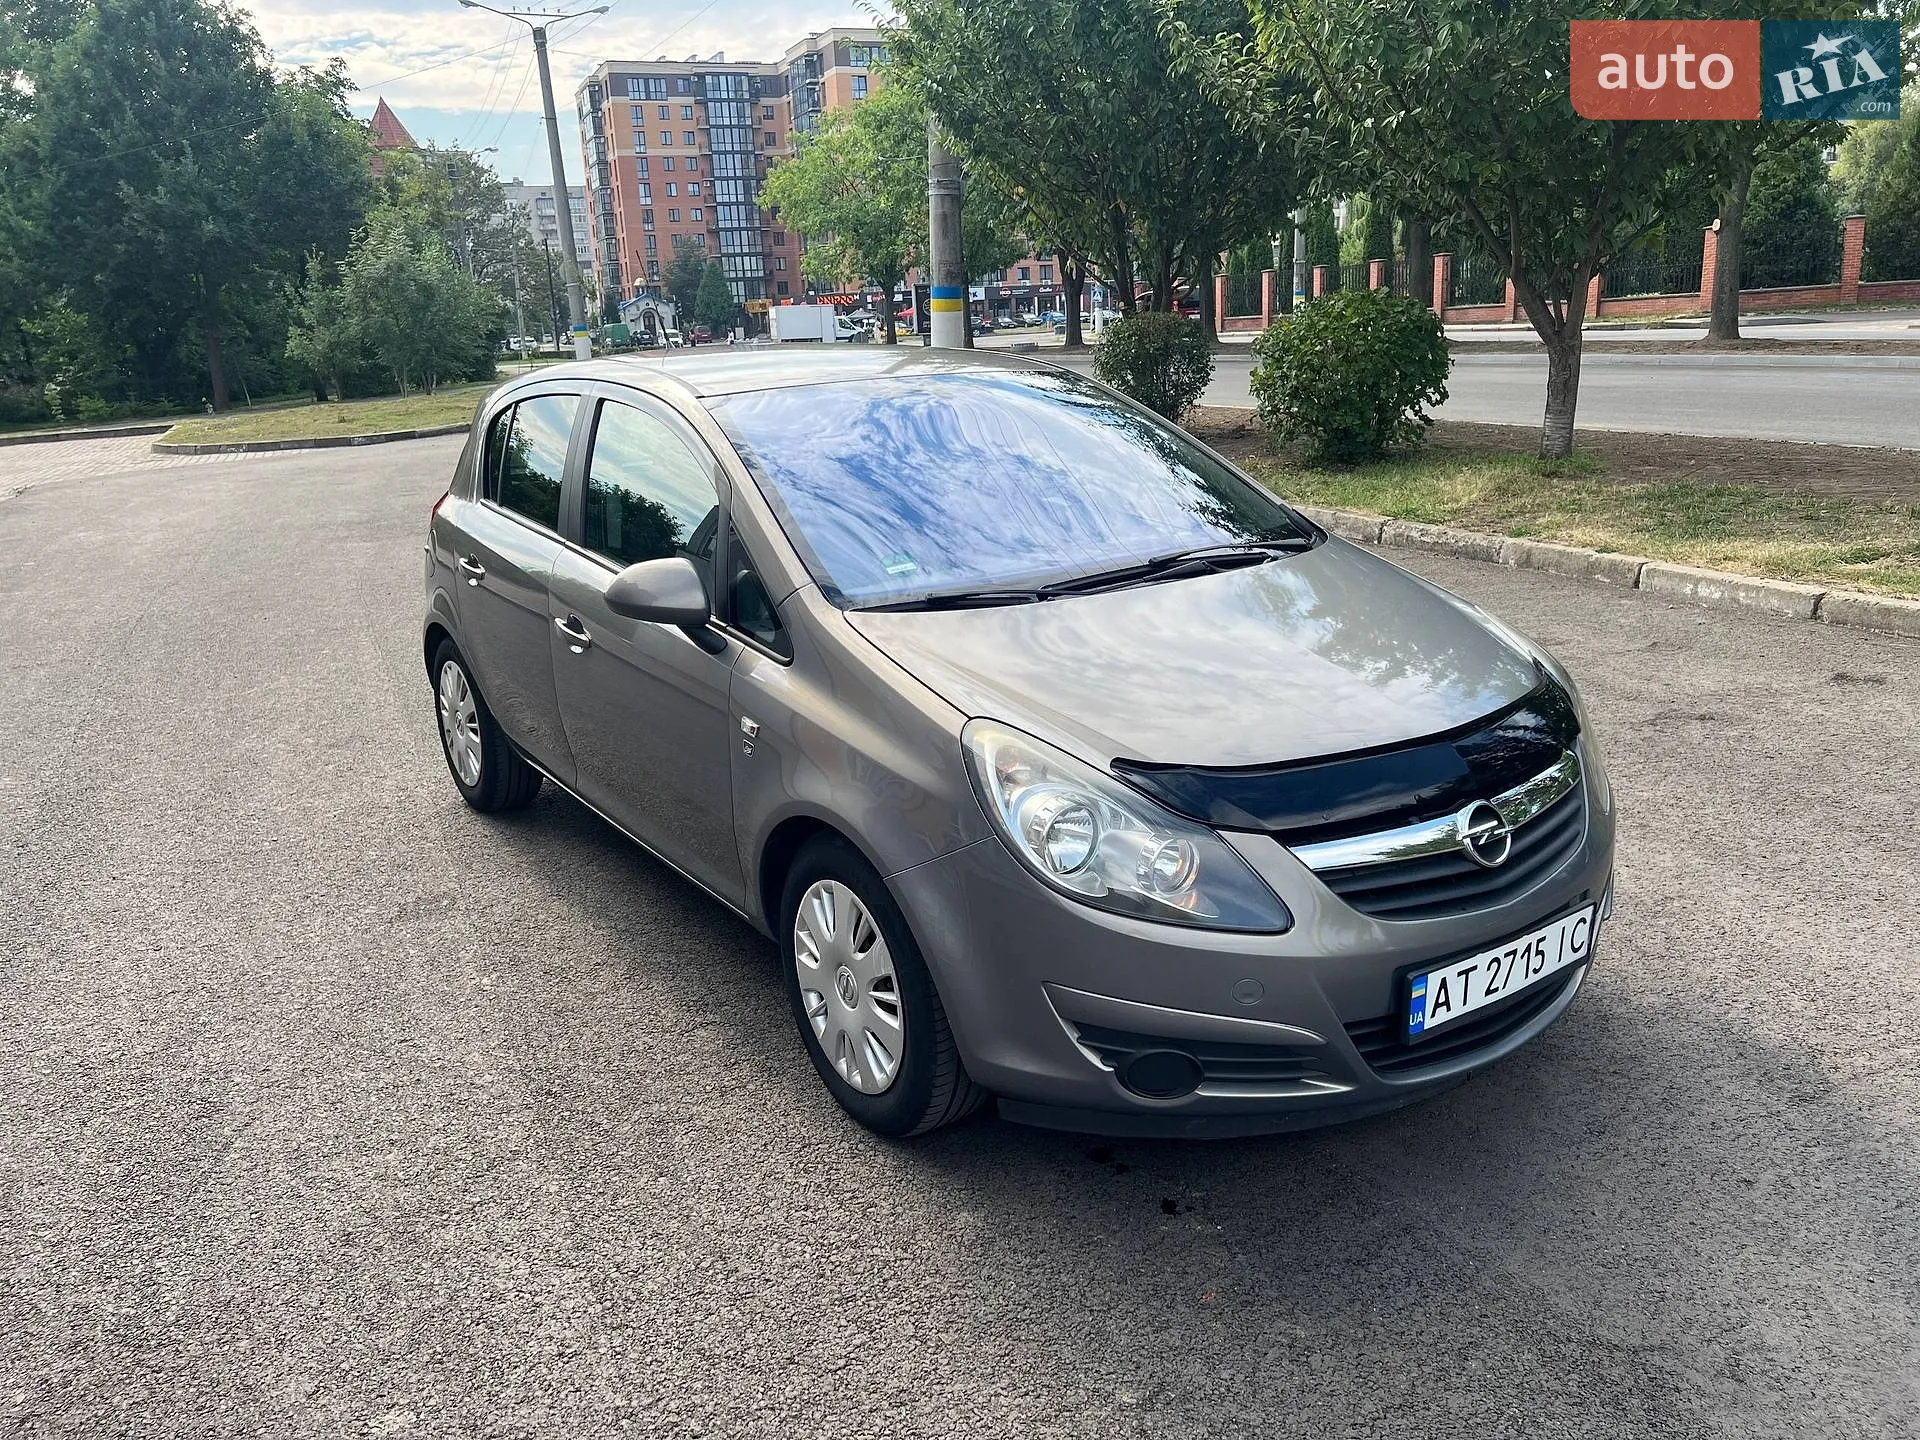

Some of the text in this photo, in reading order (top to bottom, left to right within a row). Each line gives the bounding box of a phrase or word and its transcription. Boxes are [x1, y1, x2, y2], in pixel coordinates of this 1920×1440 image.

[1430, 916, 1588, 1018] AT 2715 IC
[1410, 1011, 1423, 1025] UA
